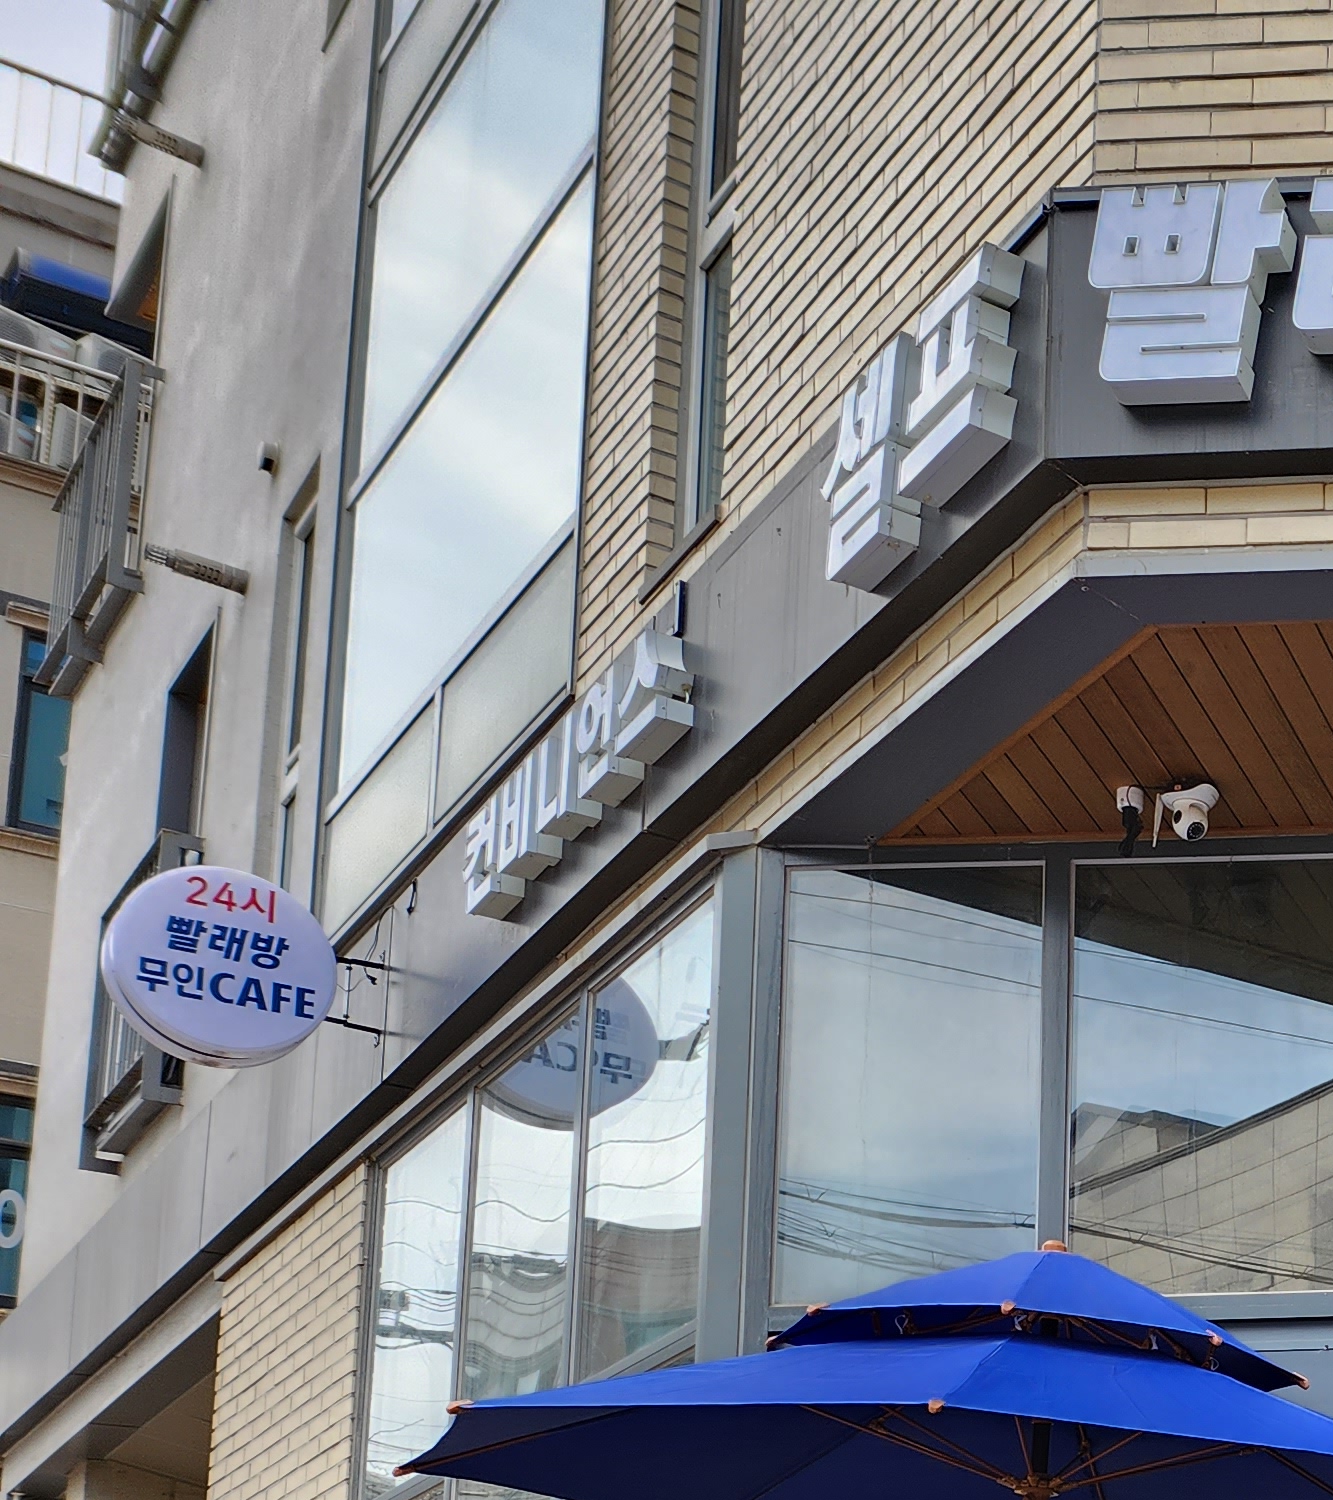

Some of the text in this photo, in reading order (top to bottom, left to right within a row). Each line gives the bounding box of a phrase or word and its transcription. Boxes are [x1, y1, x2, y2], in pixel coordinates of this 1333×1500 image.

[822, 242, 1025, 591] 셀프
[463, 628, 694, 918] 컨비니언스
[186, 876, 277, 924] 24시
[165, 914, 291, 970] 빨래방
[136, 956, 316, 1021] 무인CAFE
